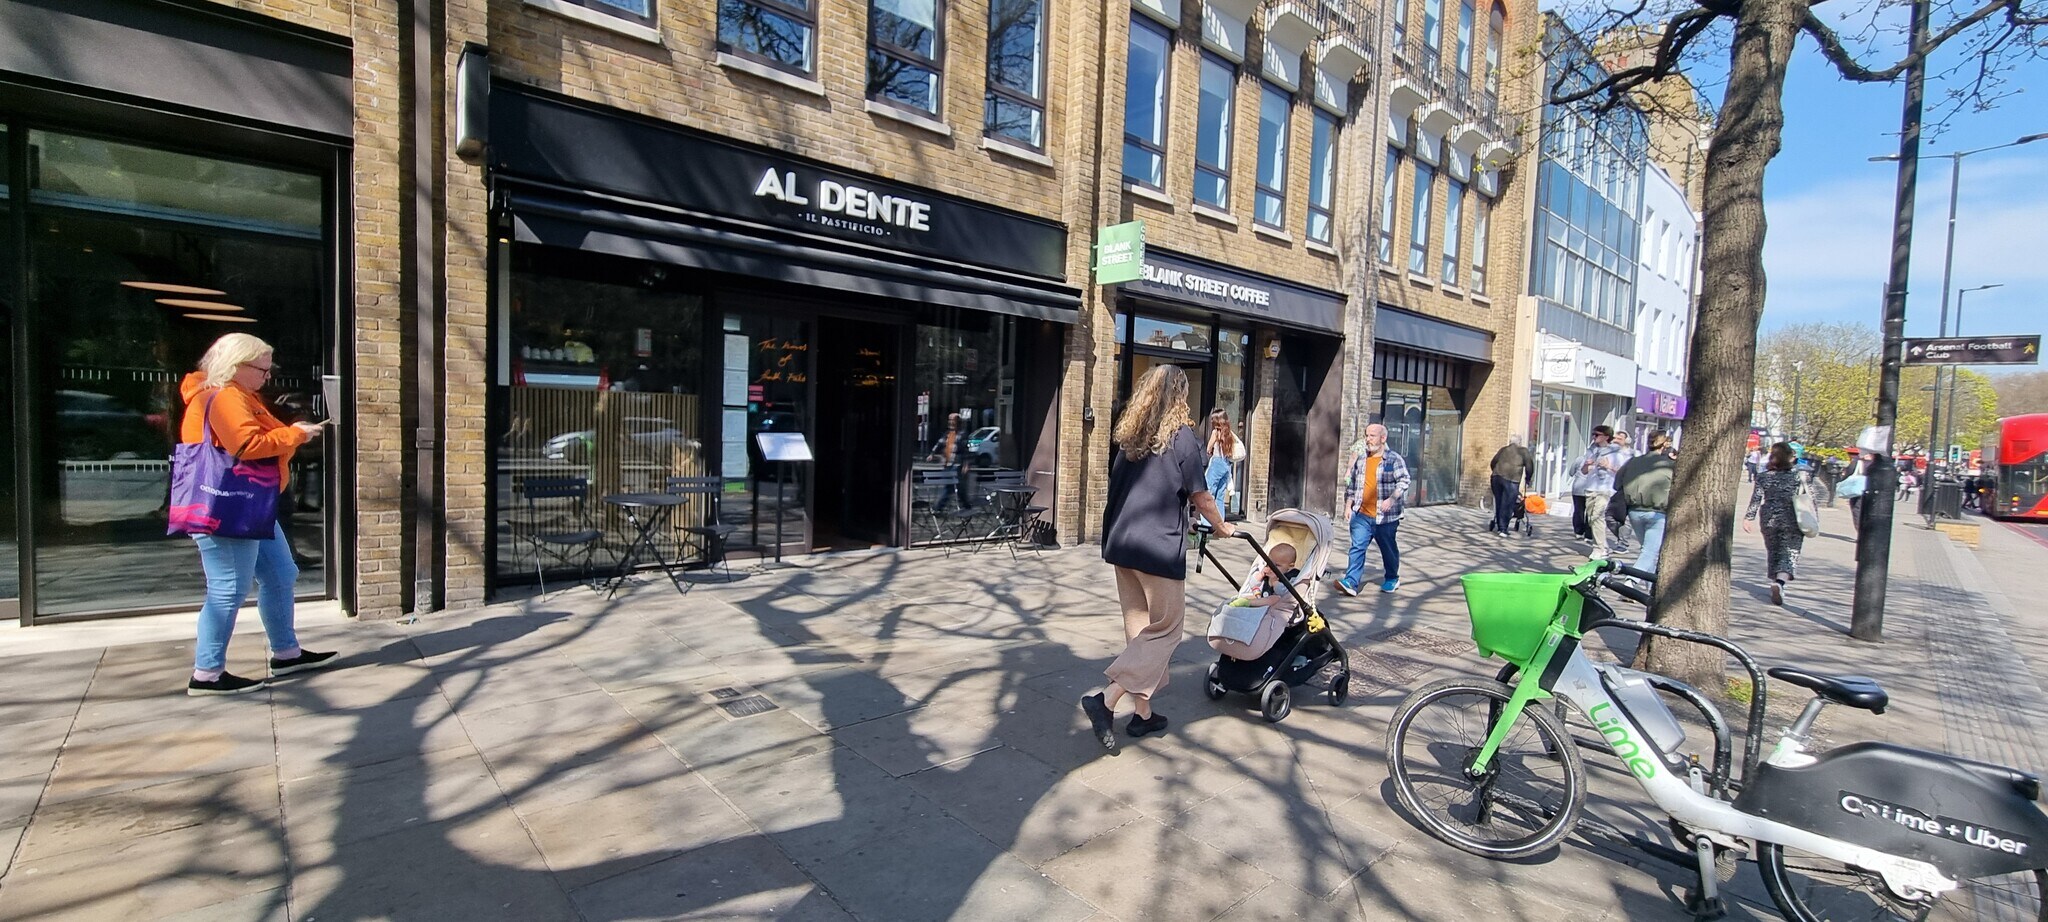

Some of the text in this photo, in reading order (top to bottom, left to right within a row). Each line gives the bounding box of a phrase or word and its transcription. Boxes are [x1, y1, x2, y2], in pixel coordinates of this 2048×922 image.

[755, 167, 930, 231] AL DENTE
[806, 213, 884, 236] IL PASTIFICIO
[1104, 240, 1132, 254] BLANK
[1101, 252, 1134, 267] STREET
[1143, 265, 1270, 306] BLANK STREET COFFEE
[1926, 341, 2012, 351] Arsenal Football
[1926, 351, 1950, 359] Club
[1589, 701, 1656, 779] Lime
[1965, 827, 2028, 855] Uber
